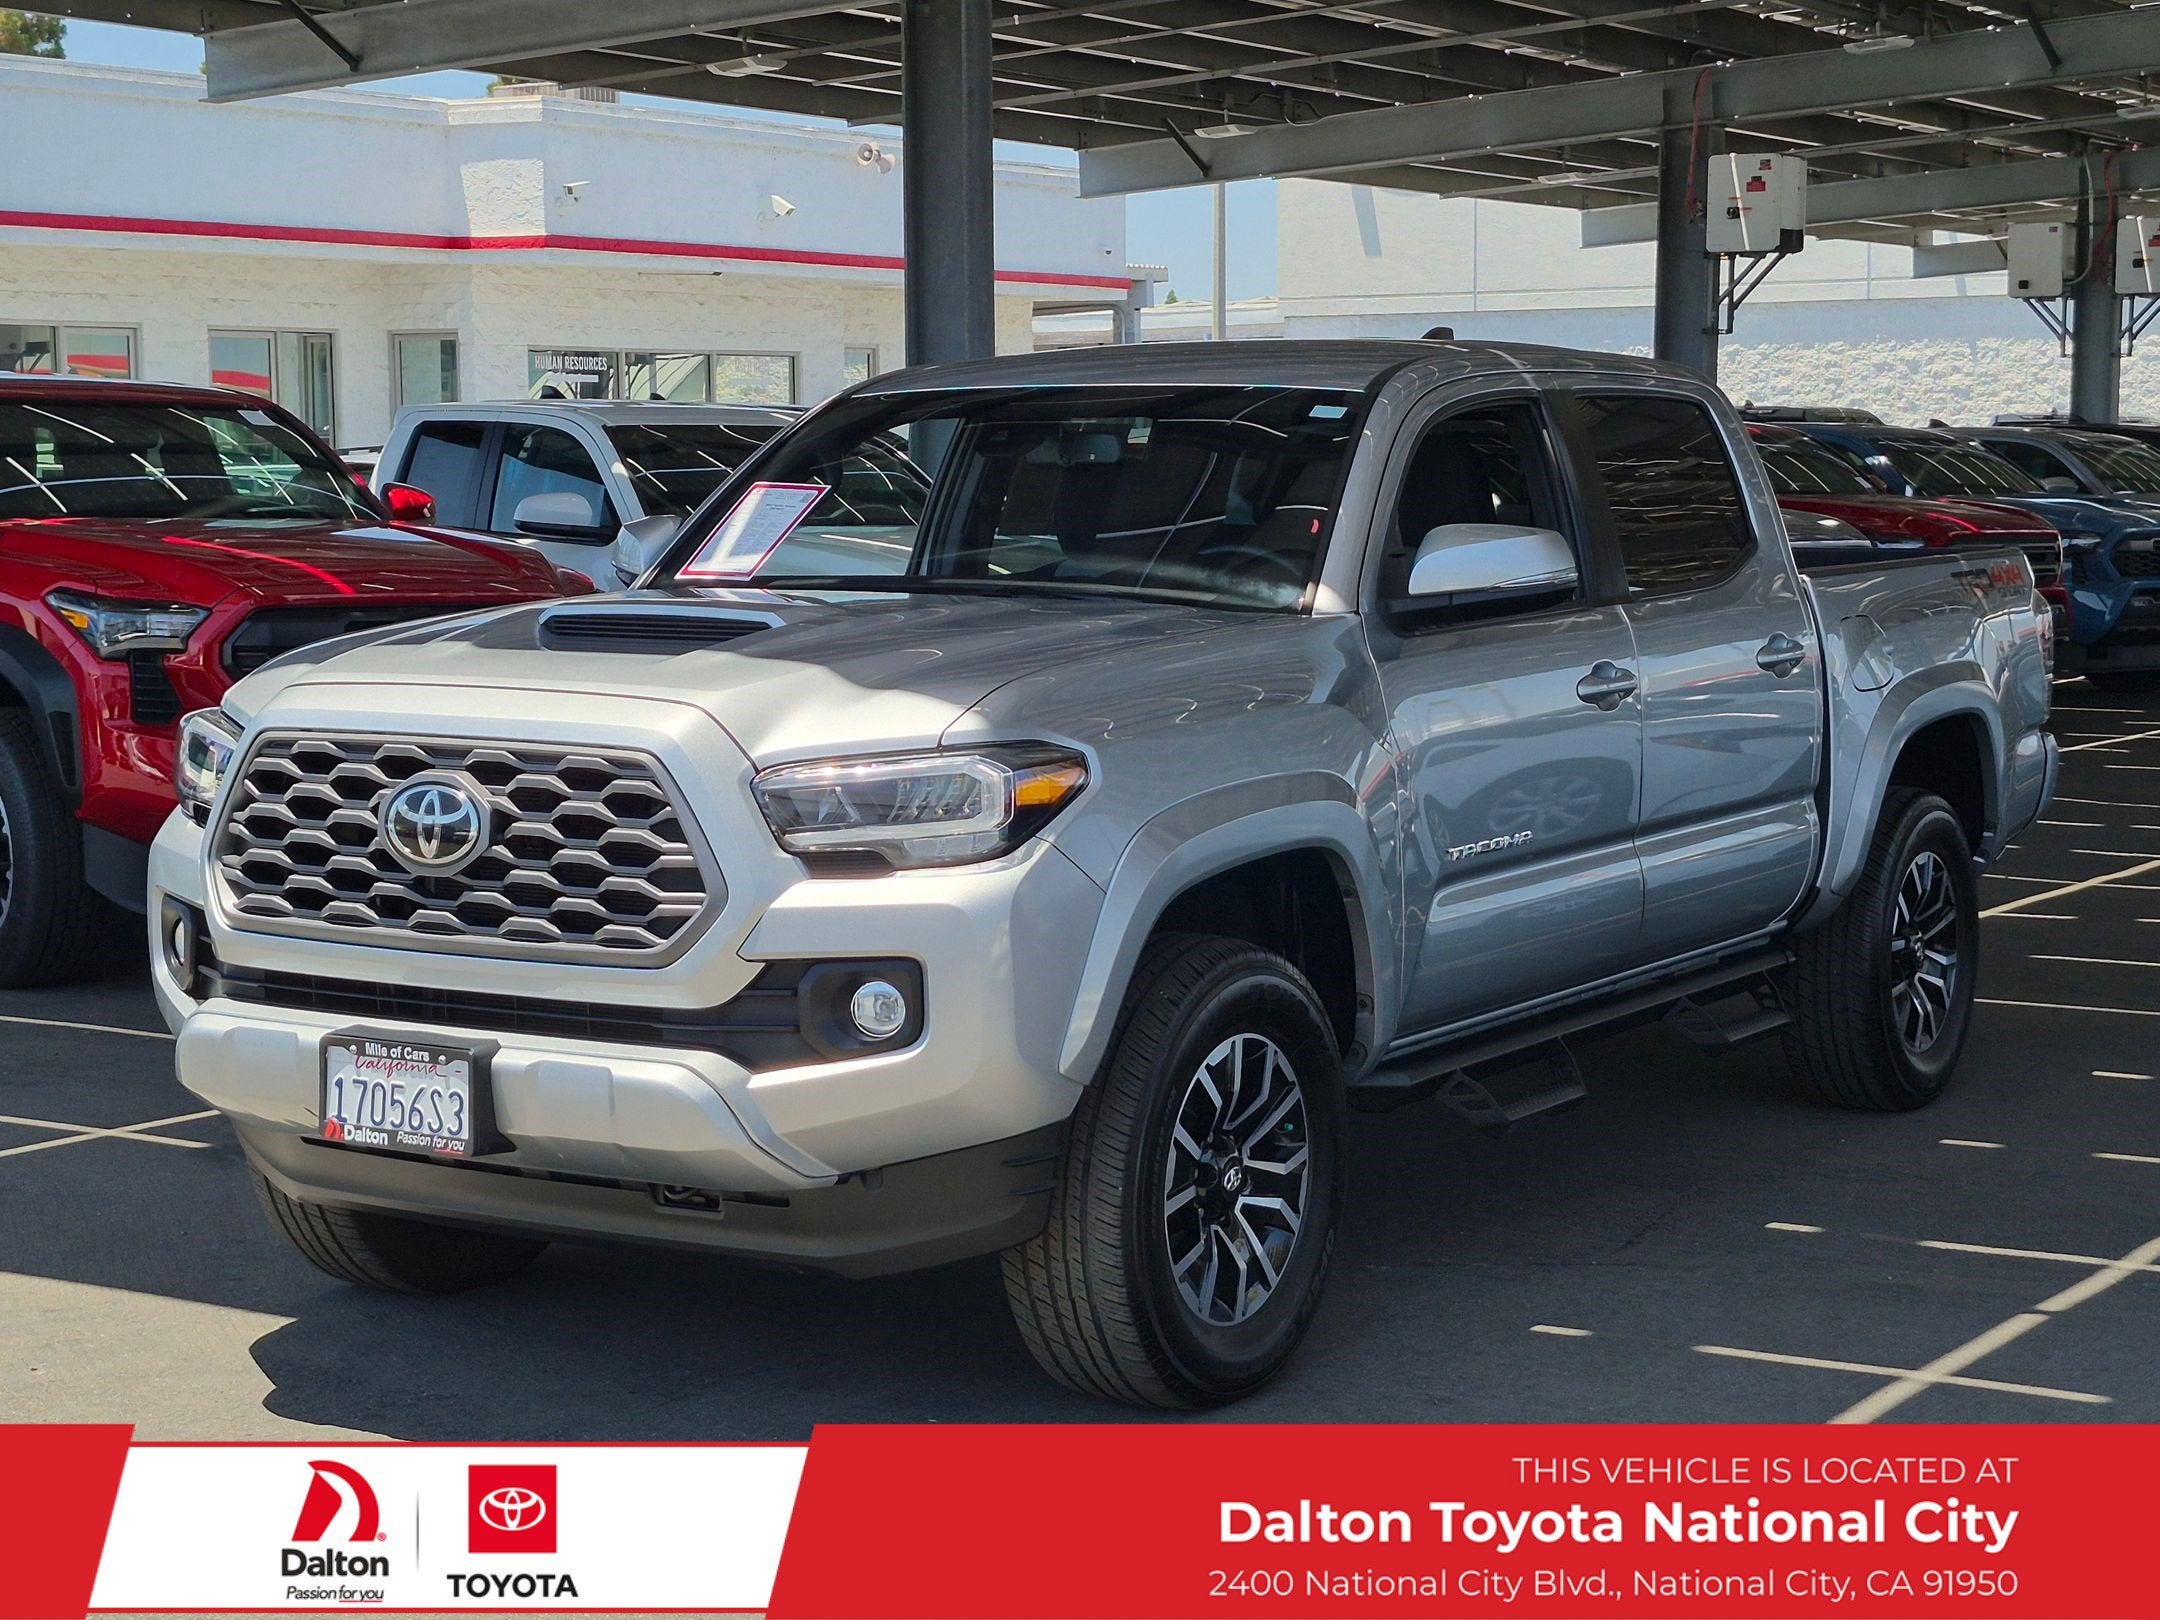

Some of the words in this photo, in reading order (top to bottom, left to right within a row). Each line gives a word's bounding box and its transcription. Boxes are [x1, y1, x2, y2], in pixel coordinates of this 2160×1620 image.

[535, 355, 562, 369] HUMAN
[564, 356, 608, 371] RESOURCES
[1447, 830, 1533, 861] TACOMA
[365, 1042, 388, 1058] Mile
[389, 1046, 402, 1059] of
[403, 1047, 430, 1062] Cars
[355, 1055, 448, 1079] California
[333, 1076, 464, 1137] 17056S3
[344, 1124, 388, 1145] Dalton
[397, 1131, 431, 1147] Passion
[432, 1136, 446, 1148] for
[447, 1140, 465, 1152] you
